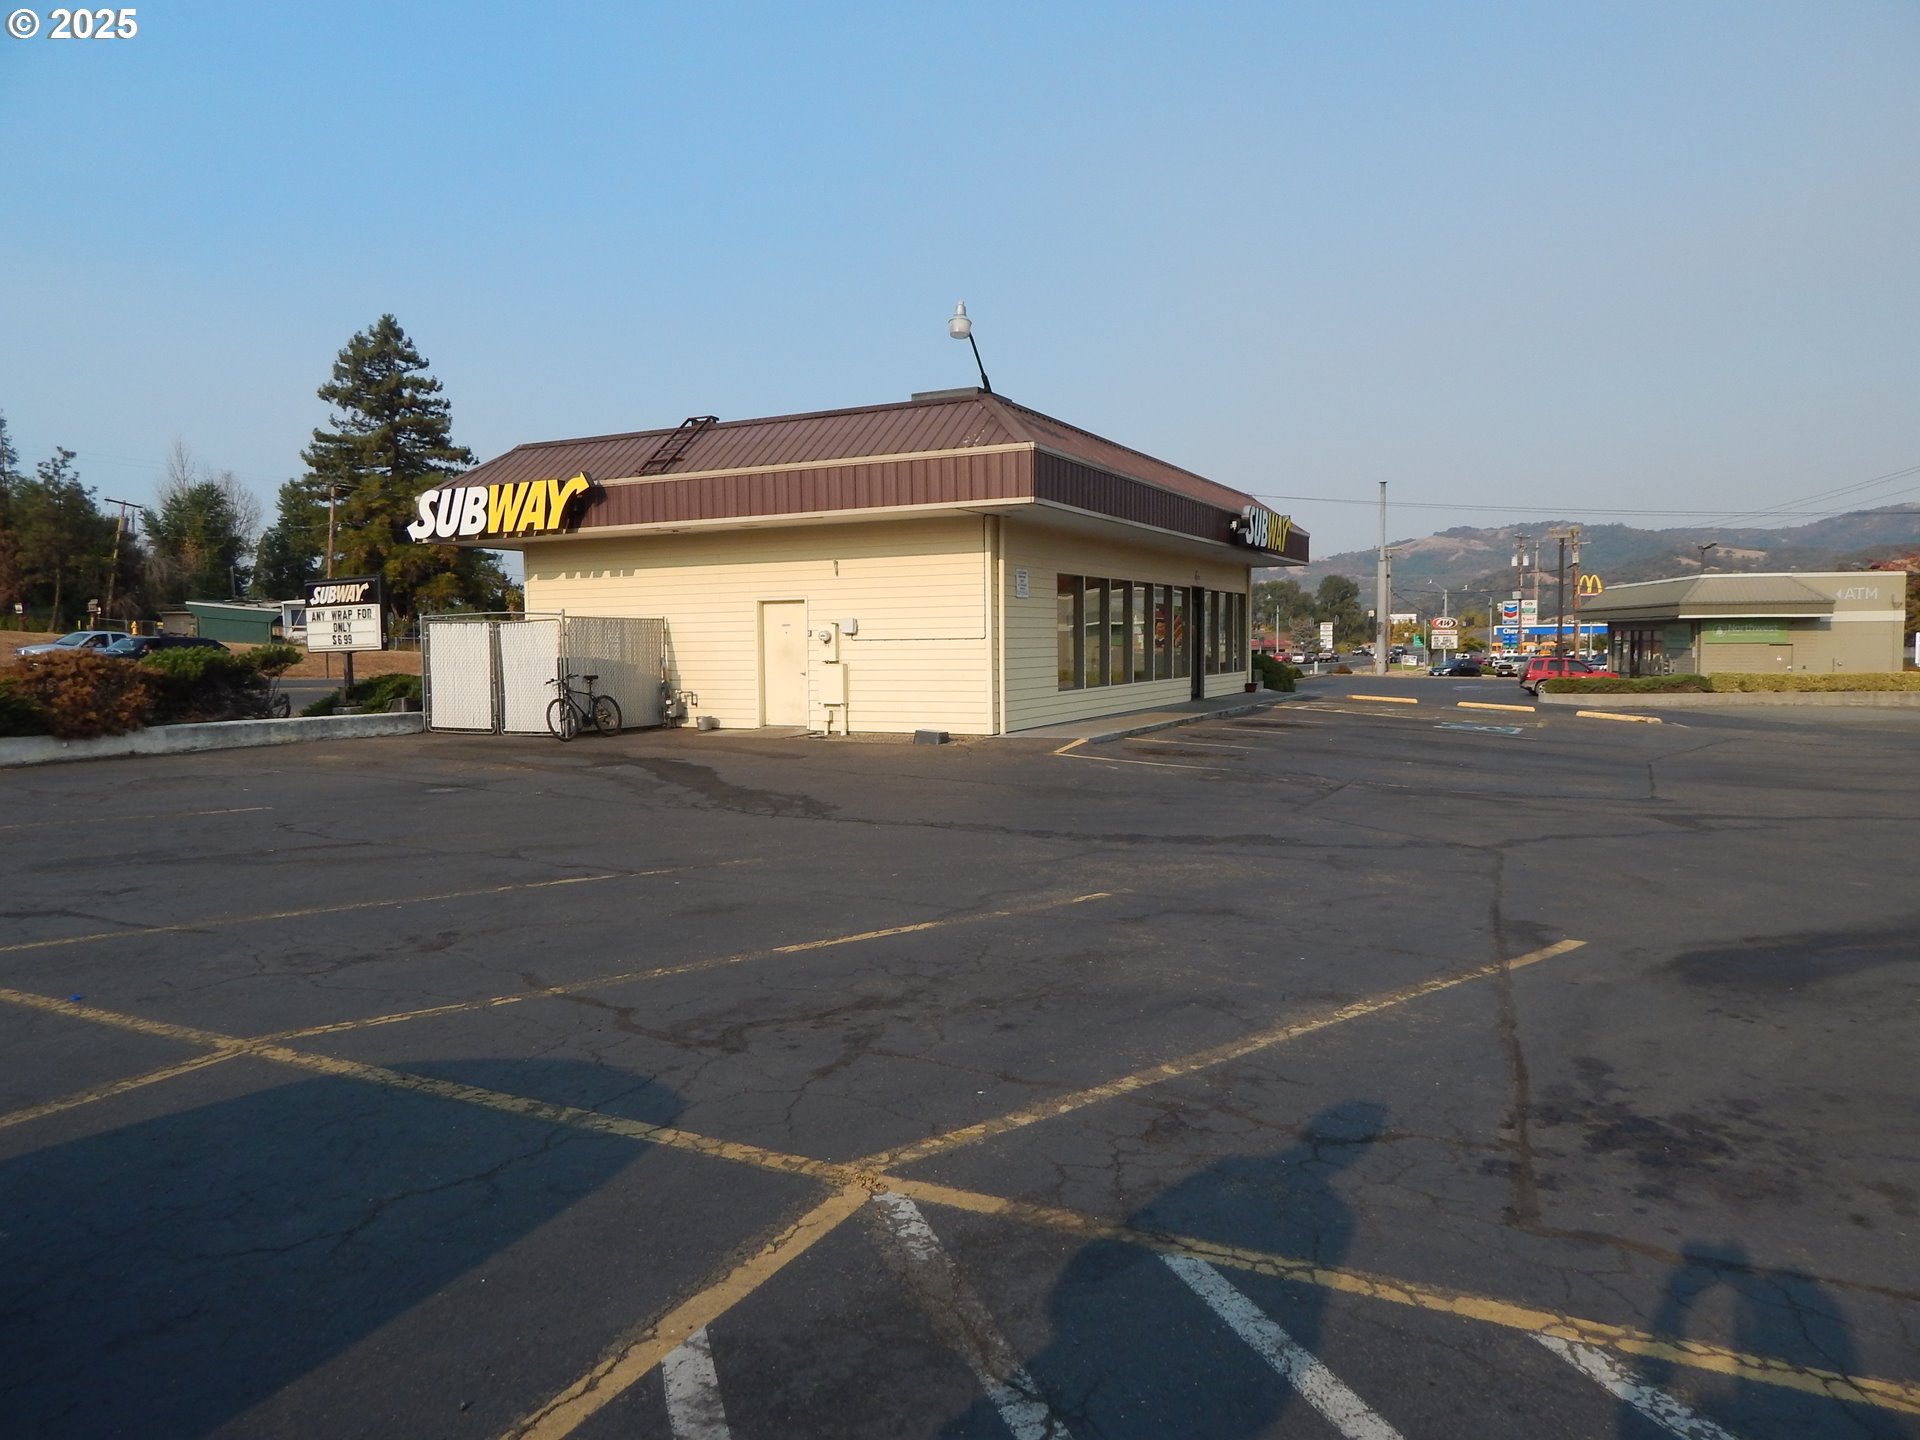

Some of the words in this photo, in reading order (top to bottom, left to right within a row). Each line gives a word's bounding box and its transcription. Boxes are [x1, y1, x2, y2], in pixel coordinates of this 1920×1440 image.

[407, 471, 590, 542] SUBWAY
[1245, 505, 1291, 553] SUBWAY
[309, 582, 370, 606] SUBWAY
[1844, 587, 1878, 600] ATM
[311, 611, 326, 622] ANY
[331, 609, 353, 621] WRAP
[357, 608, 372, 619] FOR
[333, 622, 352, 633] ONLY
[1728, 624, 1778, 632] Northwest
